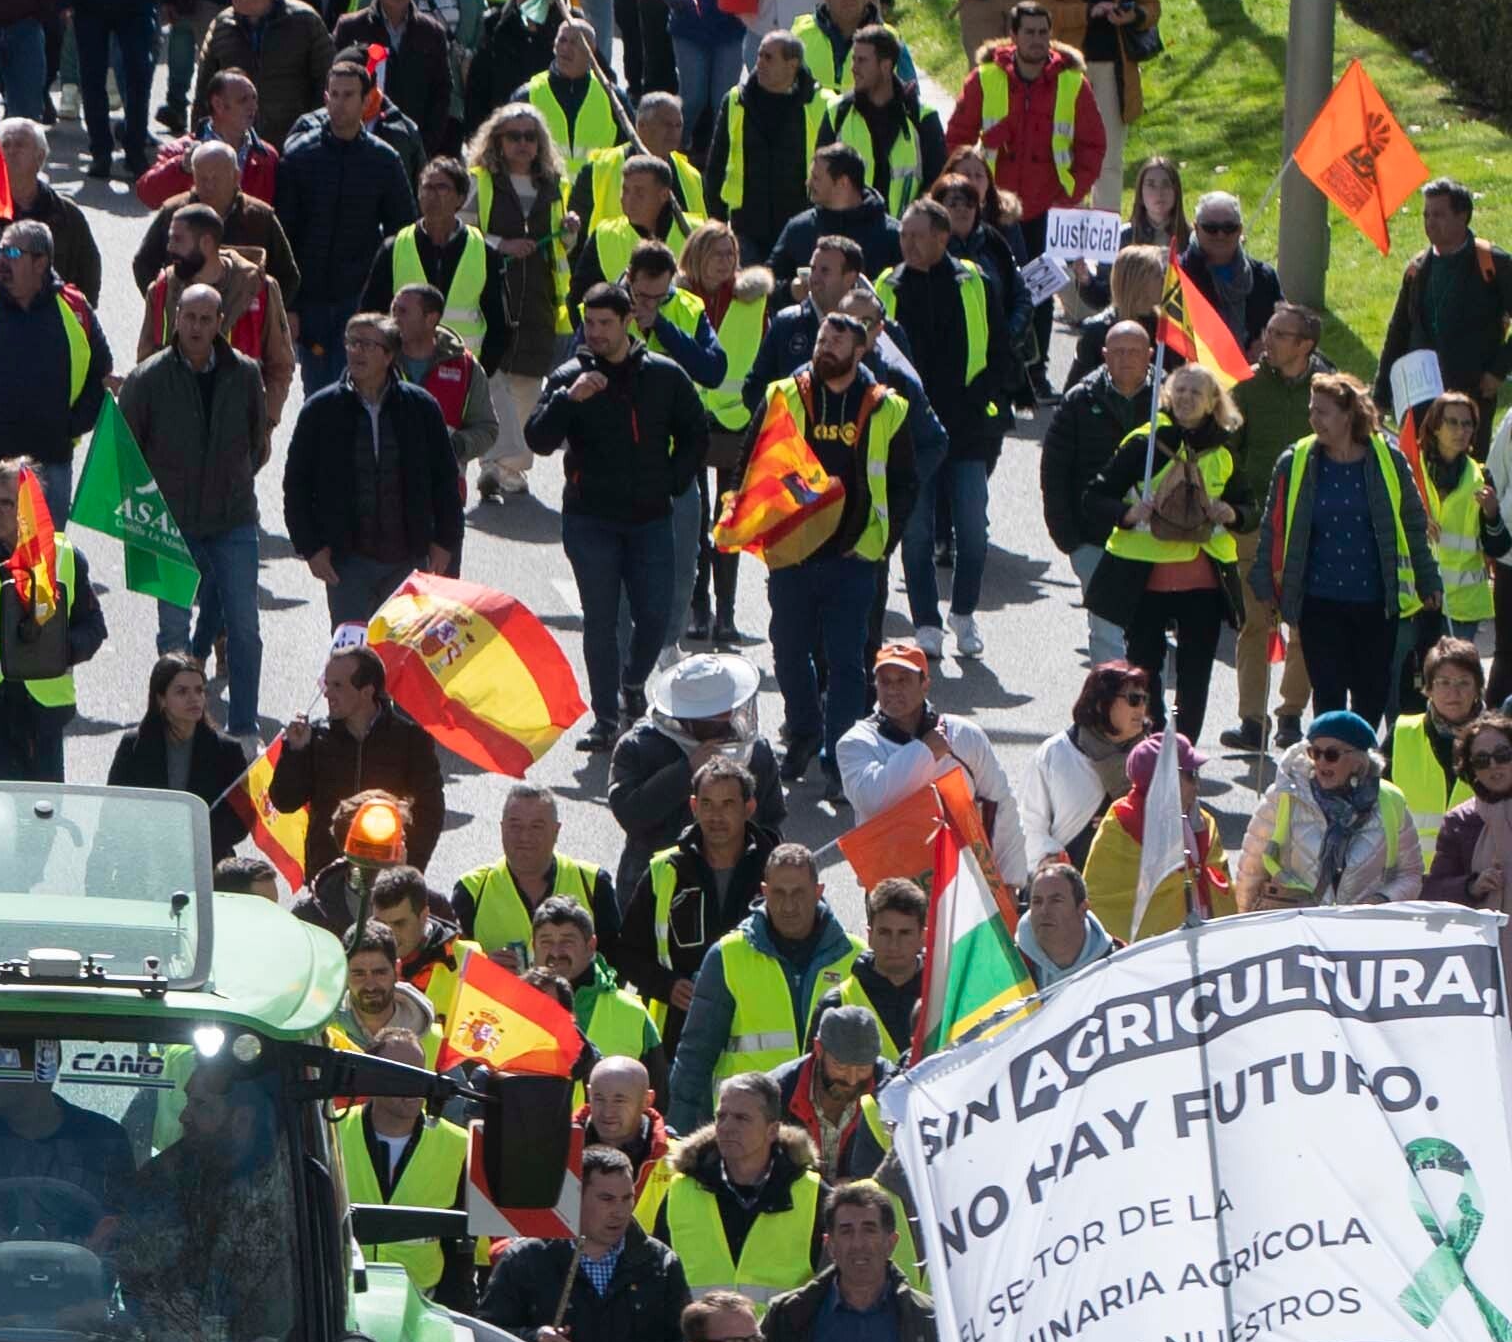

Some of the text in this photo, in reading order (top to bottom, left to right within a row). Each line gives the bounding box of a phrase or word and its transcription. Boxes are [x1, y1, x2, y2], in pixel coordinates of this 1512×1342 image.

[1049, 215, 1120, 252] Justicia!
[71, 1052, 165, 1076] CANO
[919, 953, 1498, 1165] SIN AGRICULTURA,
[939, 1181, 1009, 1268] NO
[1027, 1099, 1147, 1205] HAY
[1118, 1198, 1177, 1237] DE
[1187, 1189, 1236, 1223] LA
[1176, 1217, 1373, 1293] AGRÍCOLA
